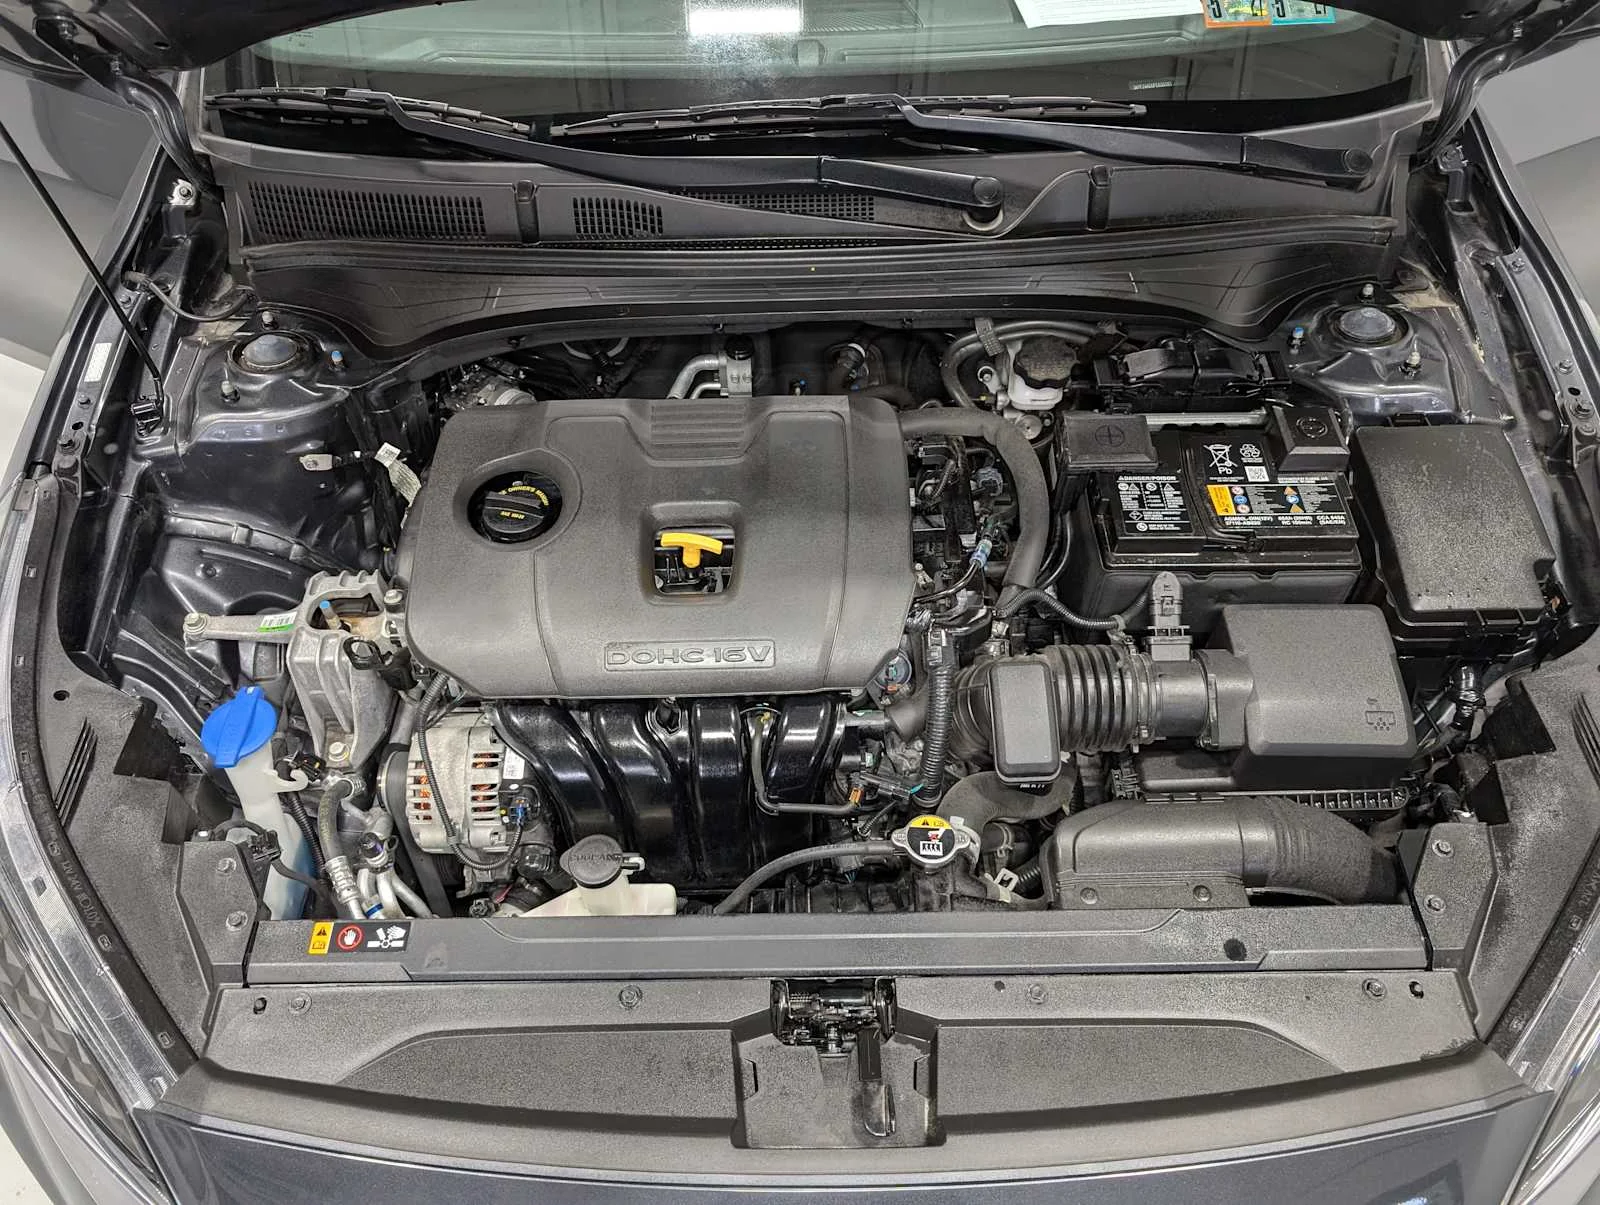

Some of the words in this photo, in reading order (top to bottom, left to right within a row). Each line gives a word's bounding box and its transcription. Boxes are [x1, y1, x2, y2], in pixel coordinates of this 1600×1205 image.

[1218, 466, 1233, 475] Pb
[606, 647, 704, 665] DOHC
[713, 645, 772, 663] 16V
